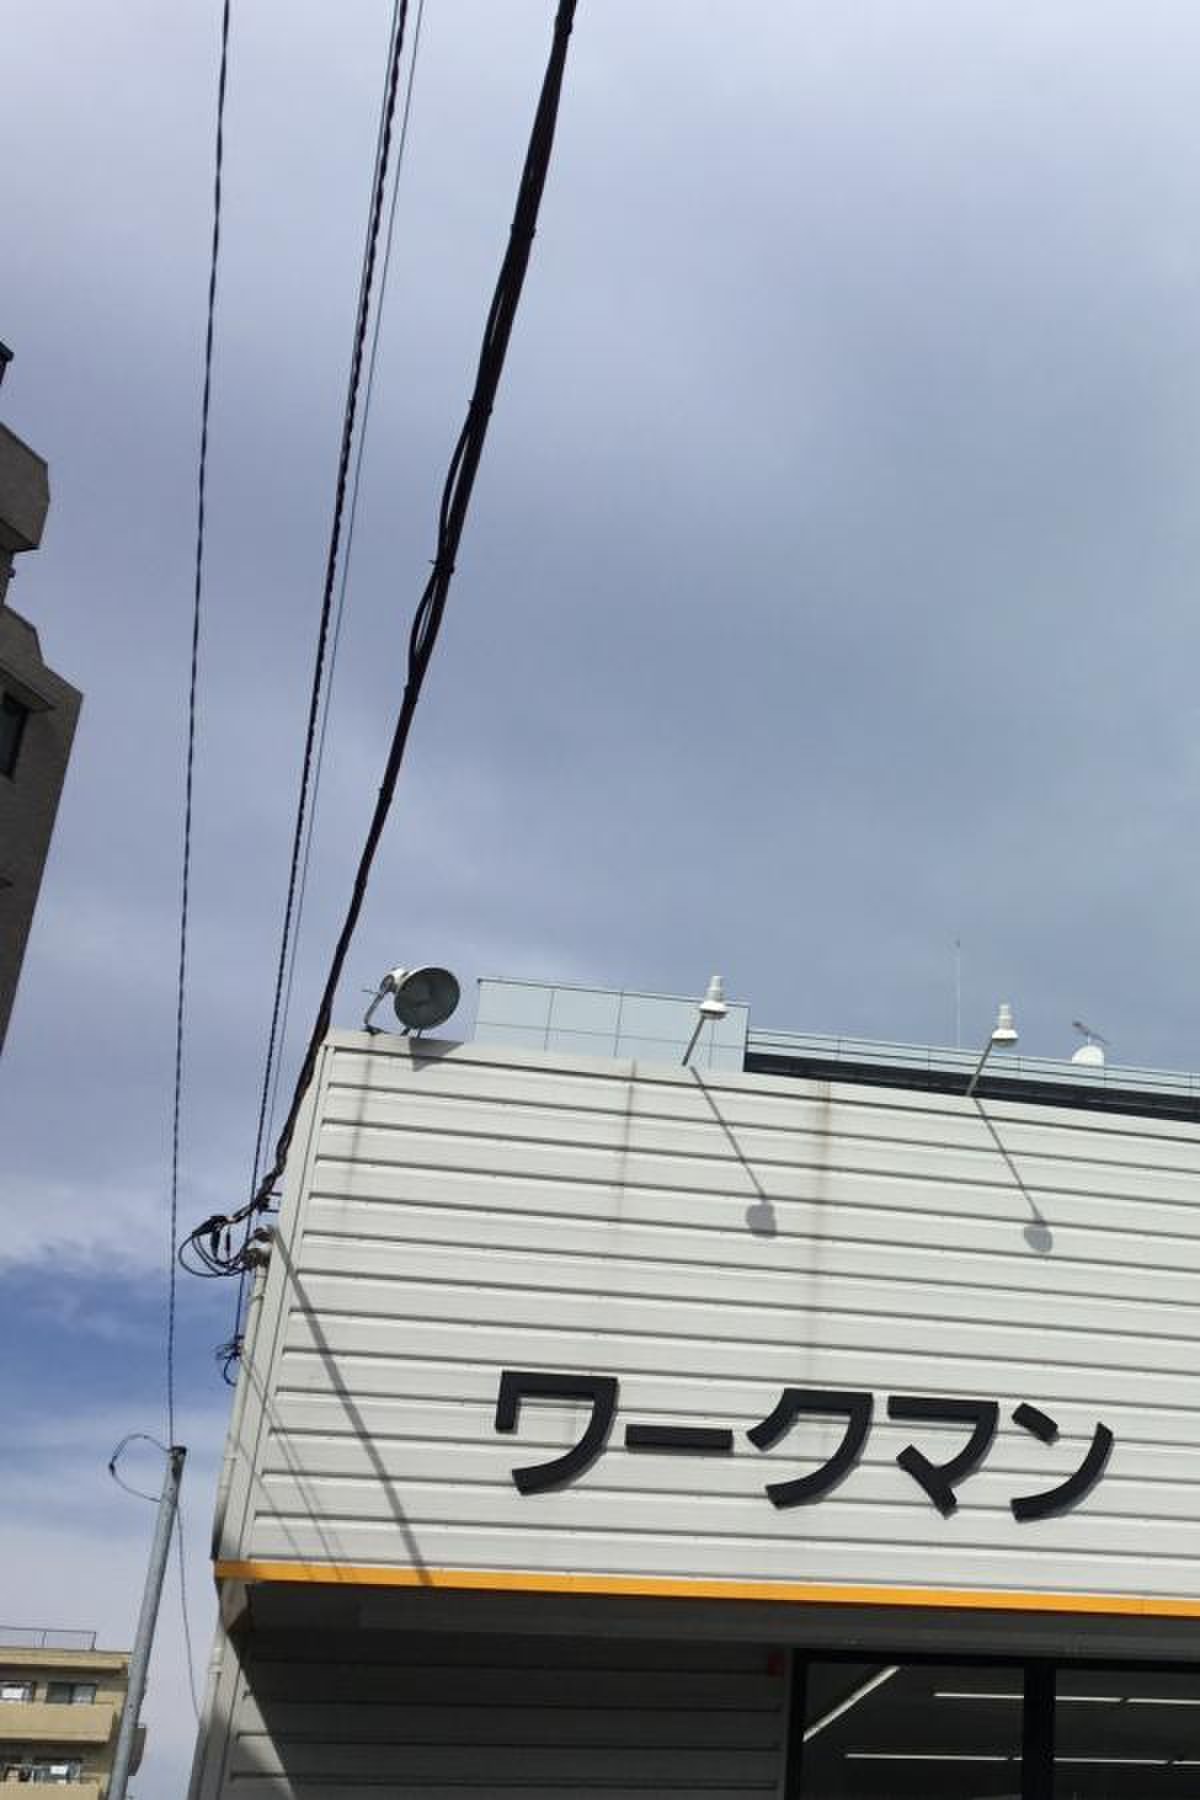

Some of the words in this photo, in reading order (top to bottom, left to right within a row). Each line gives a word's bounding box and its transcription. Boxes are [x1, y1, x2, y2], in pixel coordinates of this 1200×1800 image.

[494, 1371, 1114, 1522] ワークマン
